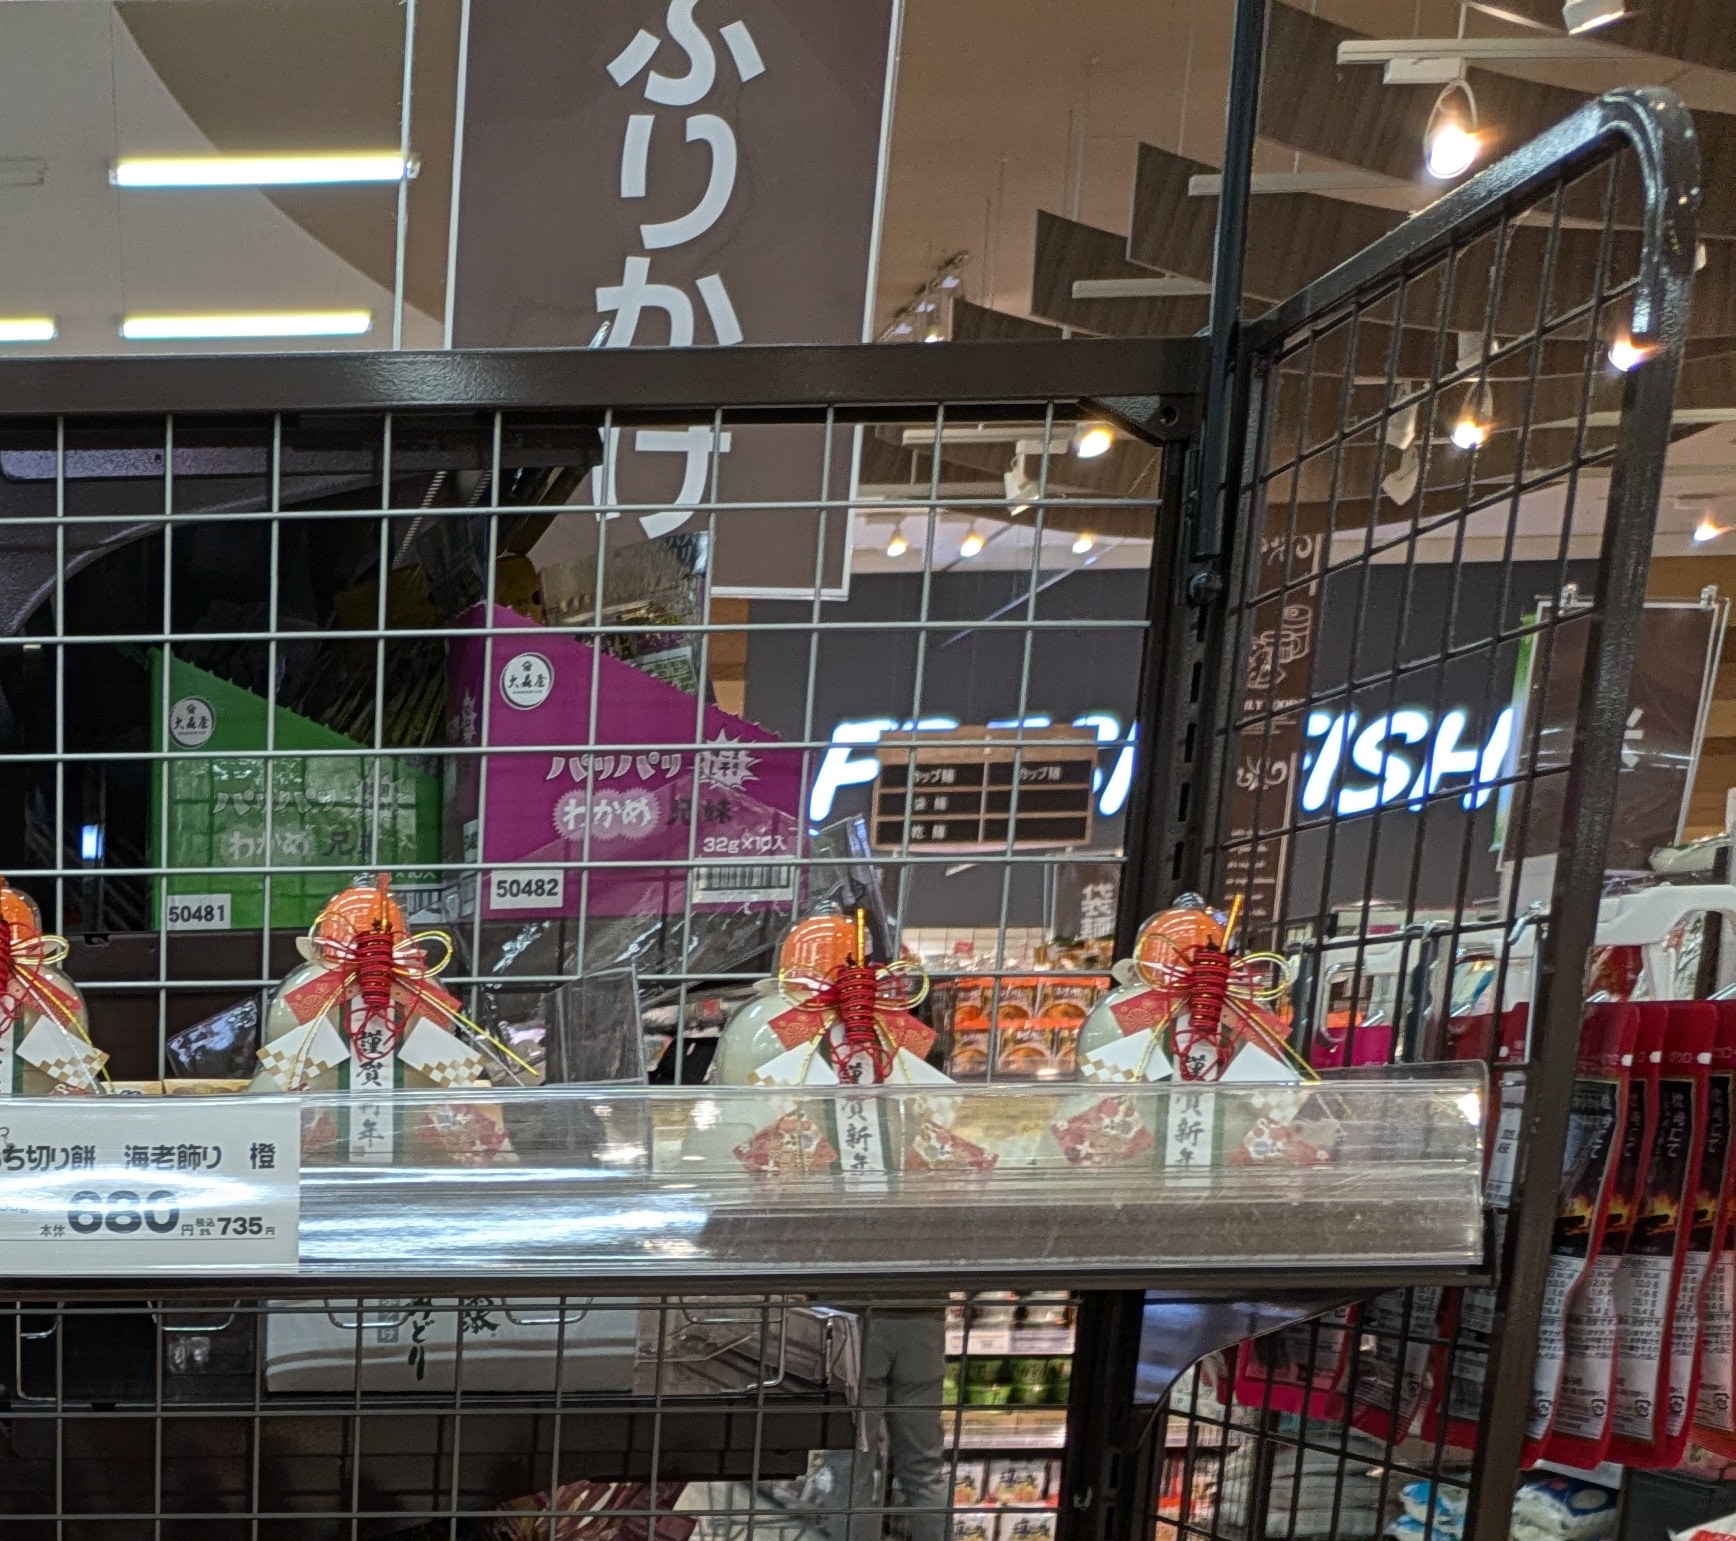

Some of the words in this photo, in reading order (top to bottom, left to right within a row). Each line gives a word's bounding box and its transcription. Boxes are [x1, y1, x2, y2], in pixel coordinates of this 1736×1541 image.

[1302, 708, 1514, 816] ISH
[495, 878, 560, 899] 50482
[168, 904, 226, 923] 50481
[124, 1144, 222, 1170] 海老飾り
[249, 1143, 275, 1171] 橙
[67, 1190, 180, 1235] 680
